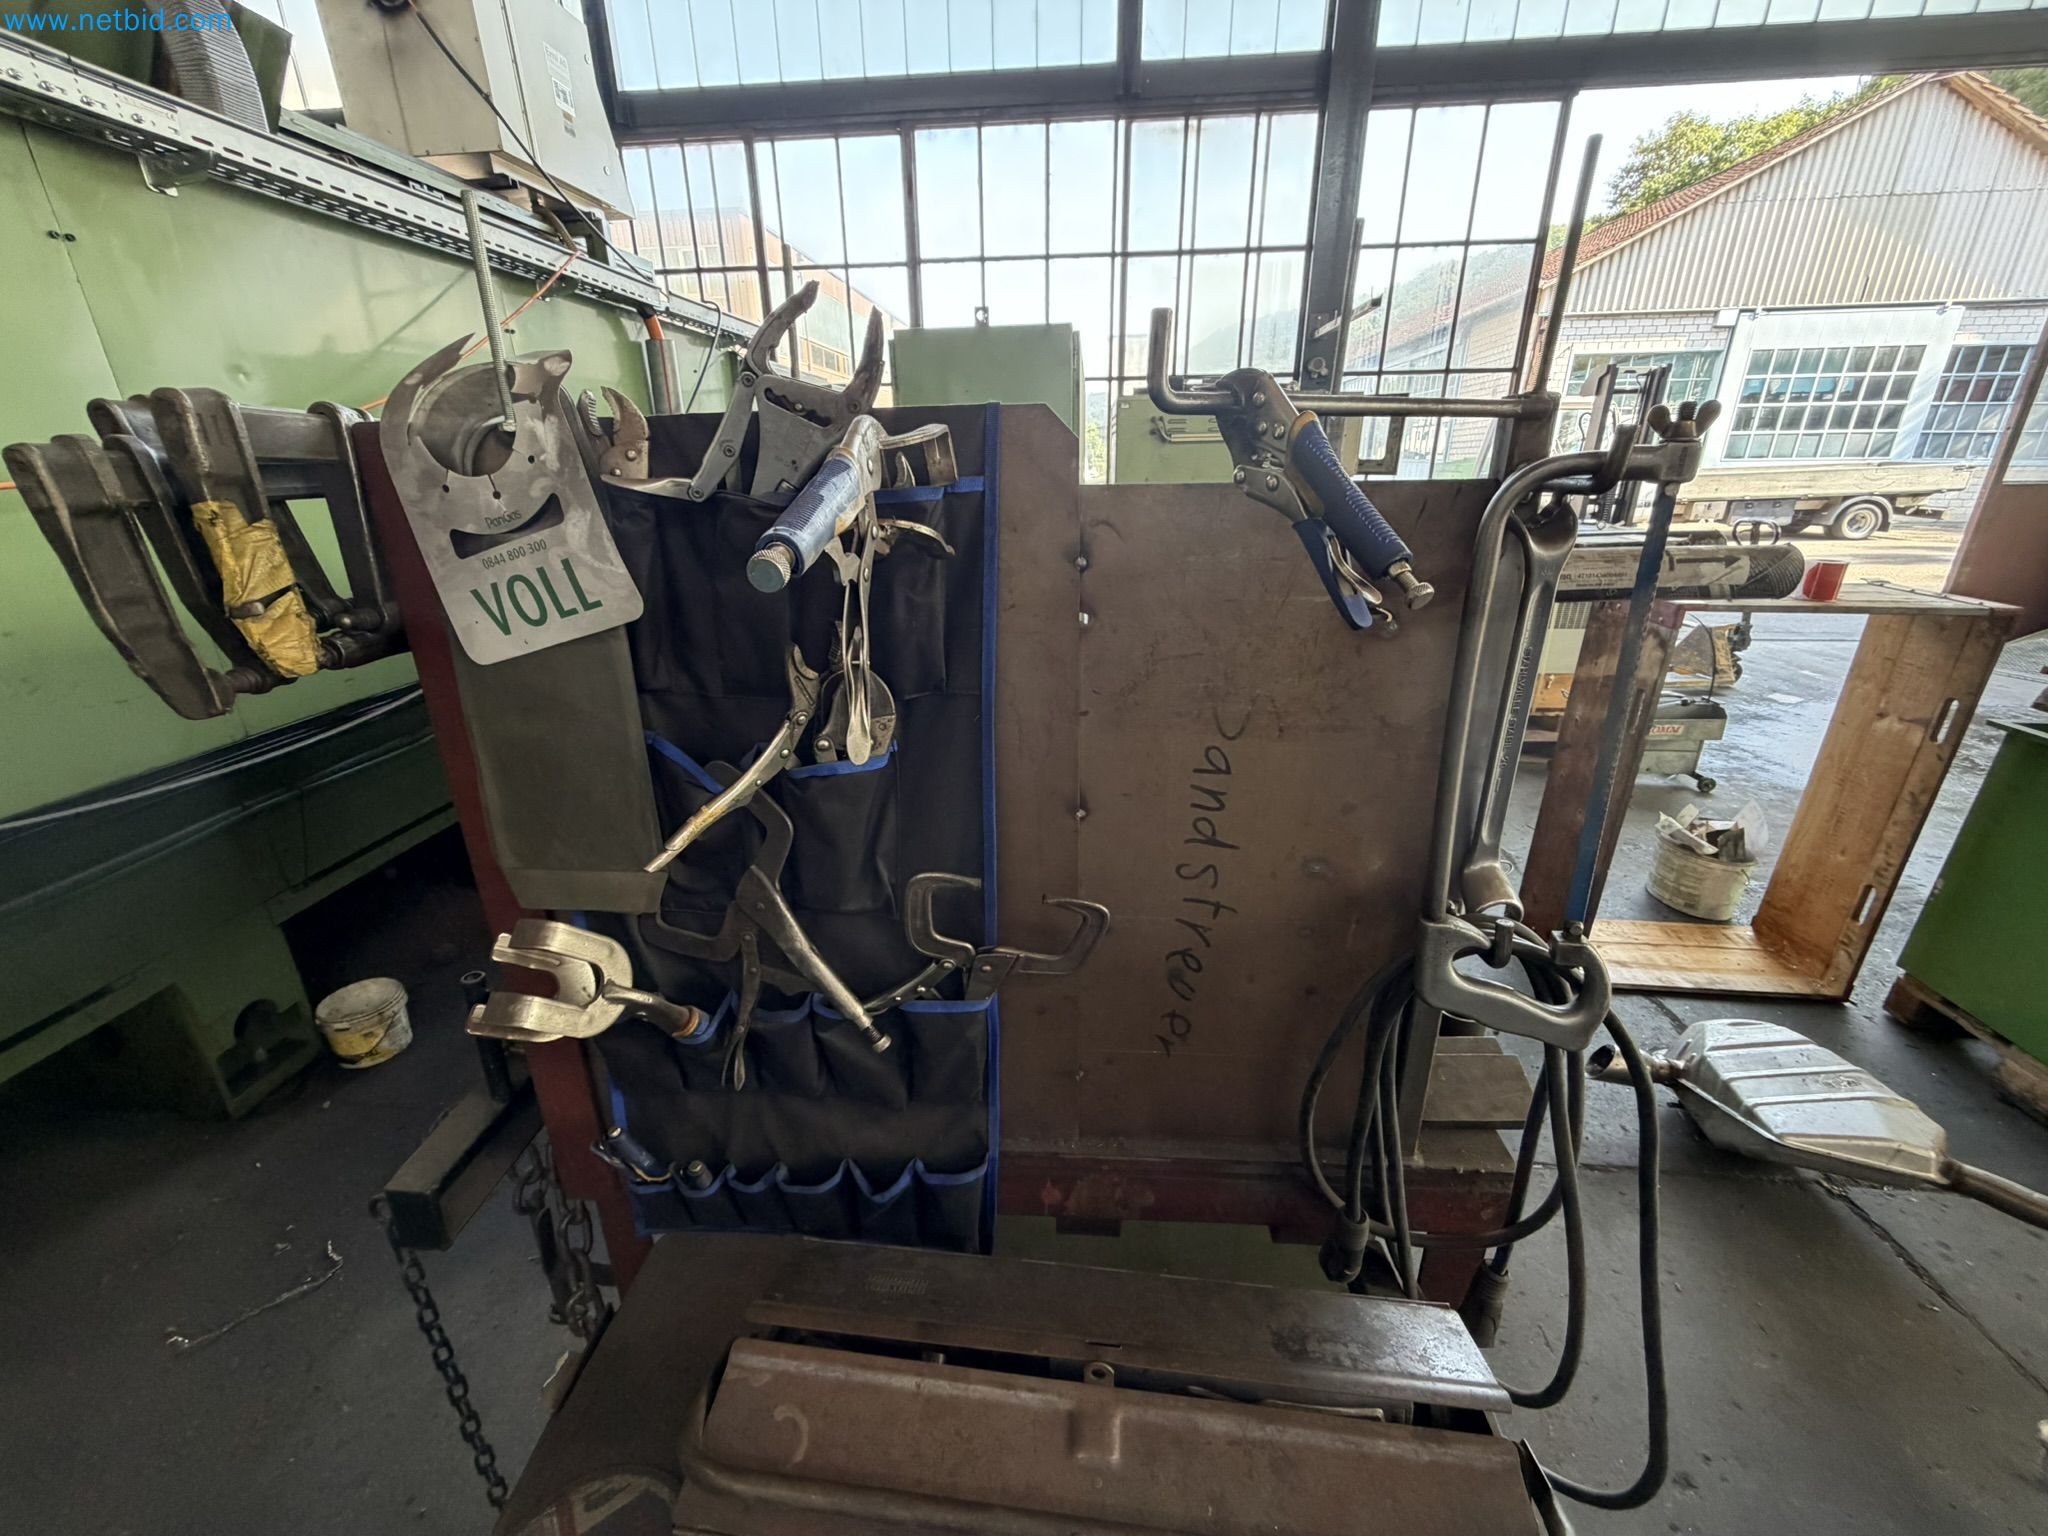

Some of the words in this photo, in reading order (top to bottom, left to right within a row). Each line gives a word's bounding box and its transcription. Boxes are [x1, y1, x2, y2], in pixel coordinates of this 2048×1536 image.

[482, 553, 506, 570] 0844
[507, 546, 526, 561] 800
[528, 539, 547, 555] 300
[469, 558, 603, 636] VOLL
